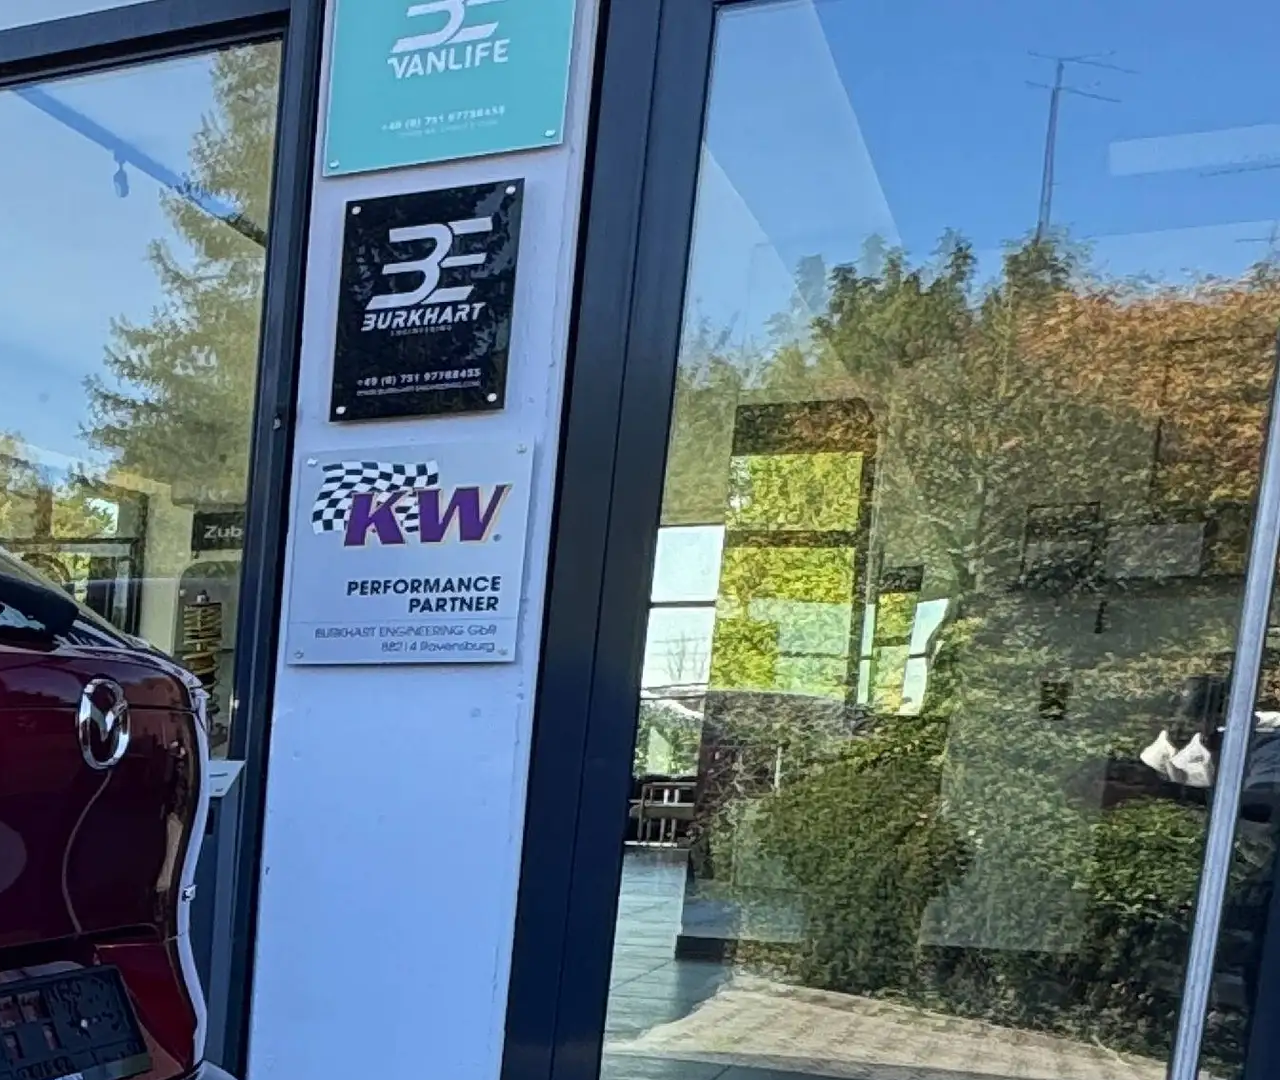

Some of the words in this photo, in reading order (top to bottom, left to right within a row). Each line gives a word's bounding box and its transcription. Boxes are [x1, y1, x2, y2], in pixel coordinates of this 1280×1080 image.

[387, 38, 510, 79] VANLIFE
[360, 301, 487, 332] BURKHART
[343, 483, 514, 547] KW
[346, 575, 501, 597] PERFORMANCE
[408, 596, 500, 614] PARTNER
[379, 624, 464, 638] ENGINEERING
